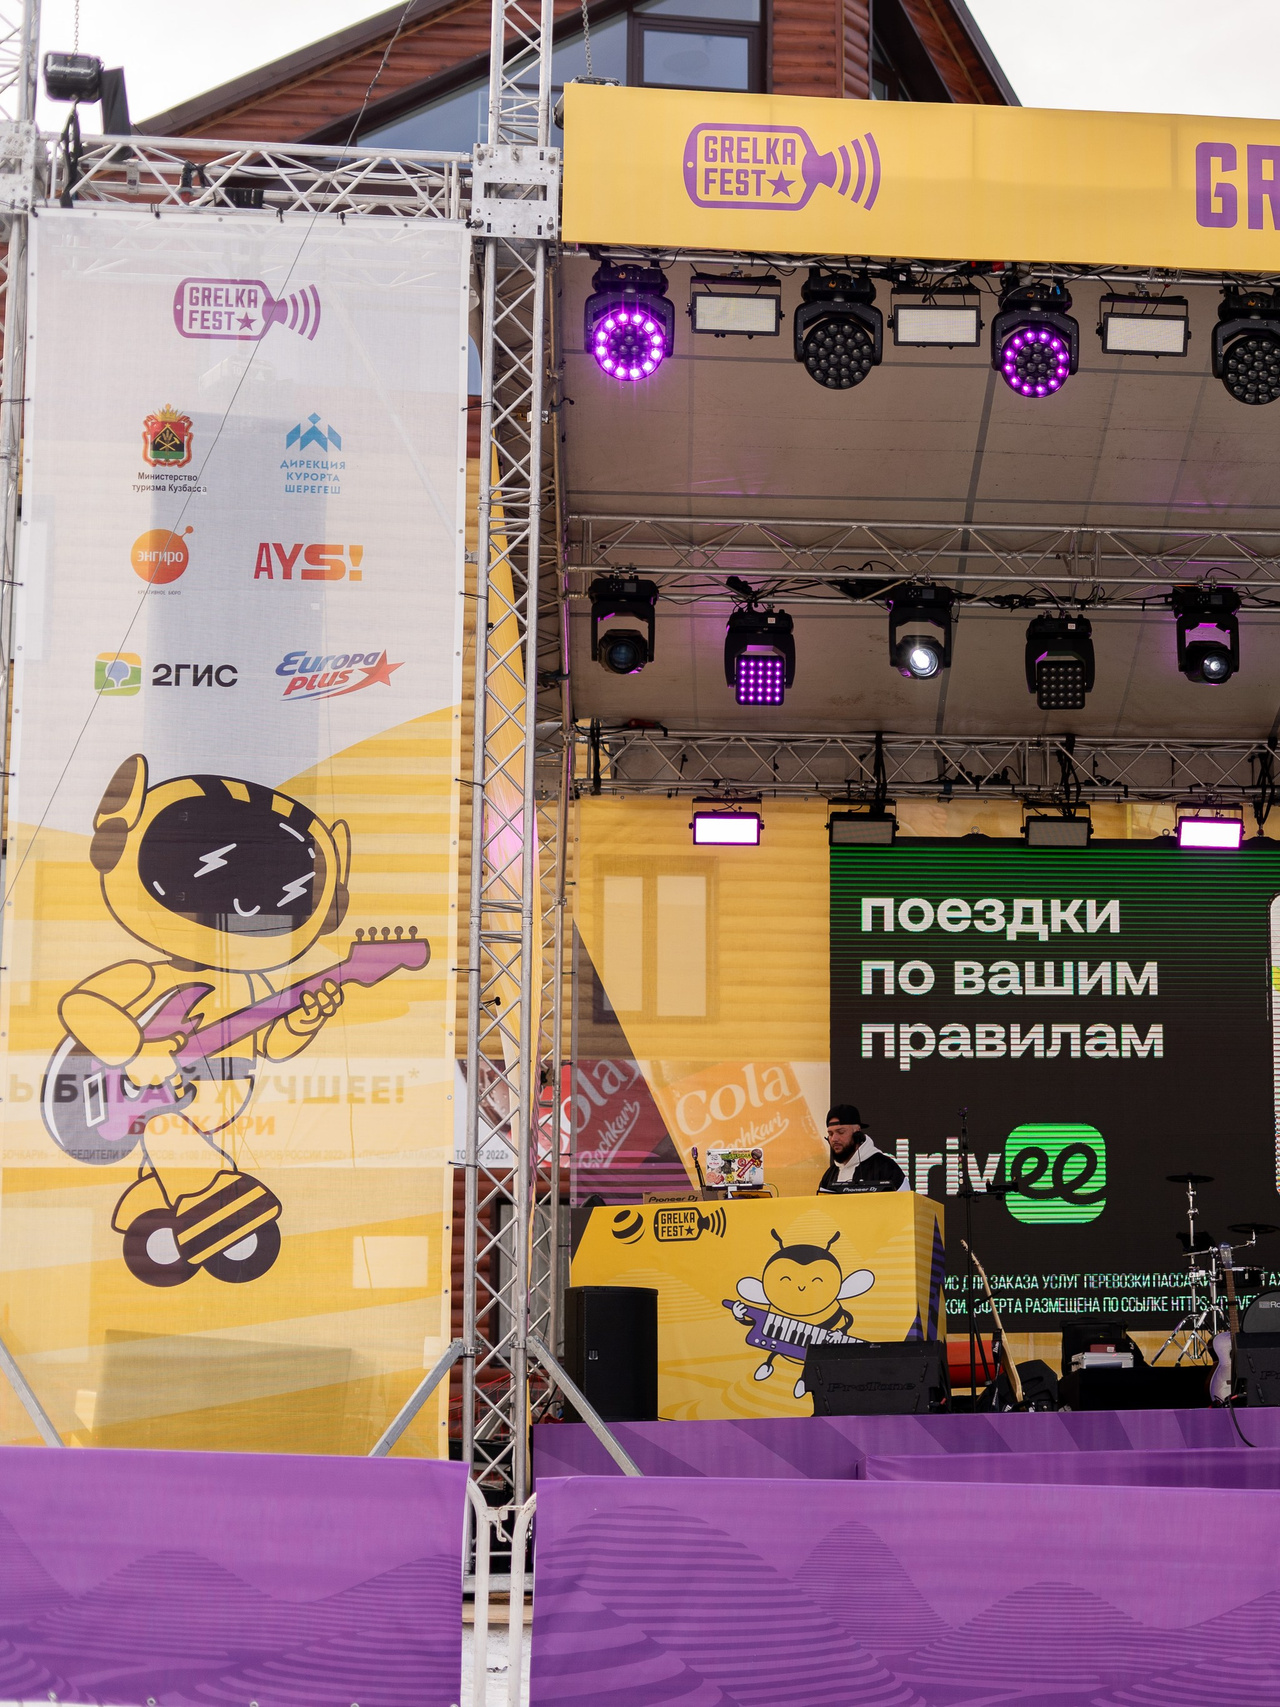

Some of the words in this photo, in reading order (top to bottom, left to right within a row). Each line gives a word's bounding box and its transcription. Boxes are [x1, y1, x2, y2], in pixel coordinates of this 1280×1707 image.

[703, 134, 797, 166] GRELKA
[703, 168, 767, 197] FEST
[188, 286, 259, 308] GRELKA
[188, 310, 236, 331] FEST
[280, 459, 346, 471] ДИРЕКЦИЯ
[137, 472, 198, 483] Министерство
[286, 472, 340, 482] КУРОРТА
[132, 485, 166, 493] туризма
[168, 484, 207, 494] Кузбасса
[285, 484, 341, 495] ШЕРЕГЕШ
[137, 550, 184, 566] энгиро
[253, 542, 364, 582] AYS!
[152, 663, 239, 688] 2ГИС
[861, 897, 1121, 941] поездки
[861, 960, 936, 996] по
[954, 960, 1159, 996] вашим
[861, 1023, 1164, 1072] правилам
[675, 1062, 792, 1136] Cola
[456, 1149, 483, 1160] ТОР
[661, 1212, 696, 1225] GRELKA
[661, 1225, 684, 1237] FEST
[990, 1273, 1039, 1290] ЗАКАЗА
[1042, 1273, 1081, 1290] УСЛУГ
[1083, 1272, 1151, 1289] ПЕРЕВОЗКИ
[1025, 1297, 1101, 1315] РАЗМЕЩЕНА
[1102, 1296, 1119, 1313] ПО
[1120, 1296, 1169, 1313] ССЫЛКЕ
[827, 1381, 916, 1392] ProTone
